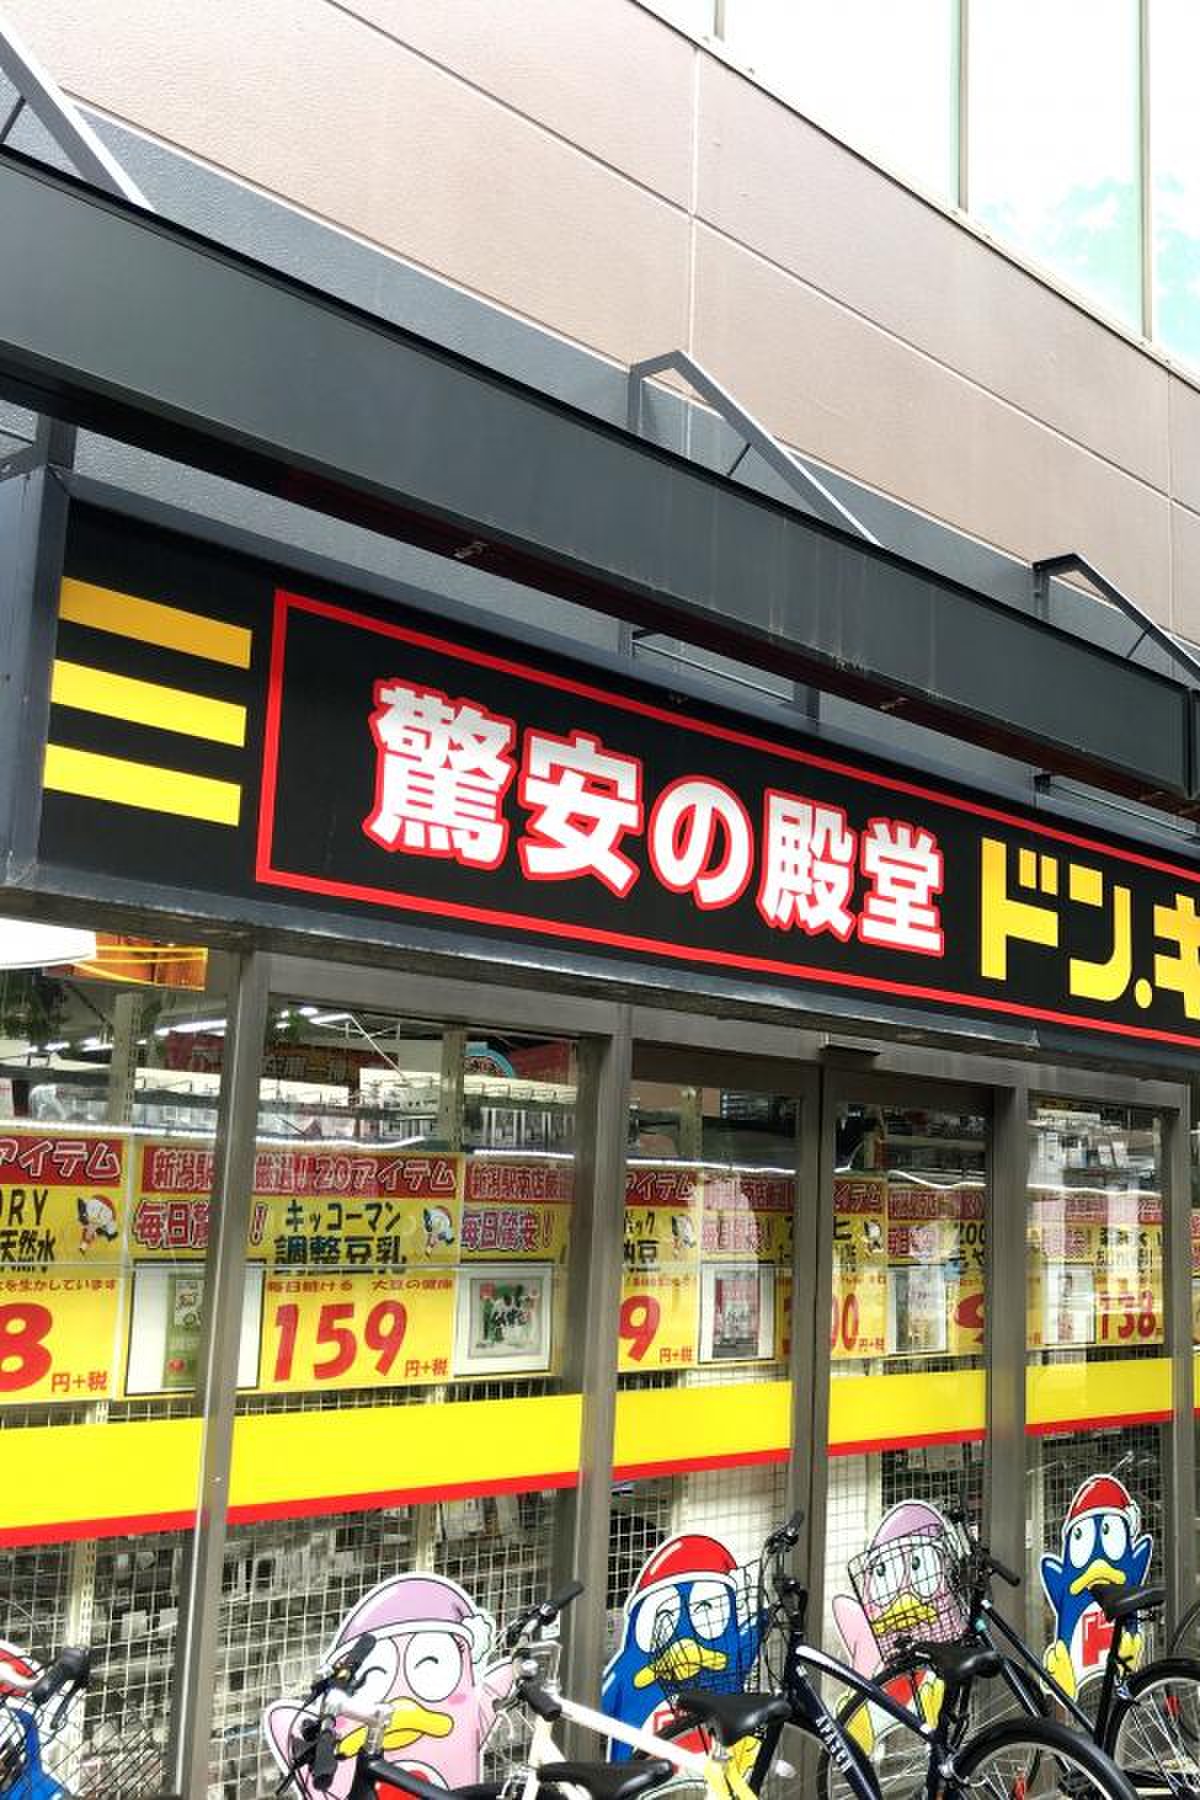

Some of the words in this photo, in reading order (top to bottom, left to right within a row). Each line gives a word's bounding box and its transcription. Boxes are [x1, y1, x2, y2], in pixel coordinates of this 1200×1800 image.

[363, 678, 944, 957] 驚安の殿堂
[0, 1188, 48, 1226] RY
[286, 1200, 401, 1232] キッコーマン
[273, 1236, 407, 1274] 調整豆乳
[274, 1299, 408, 1383] 159
